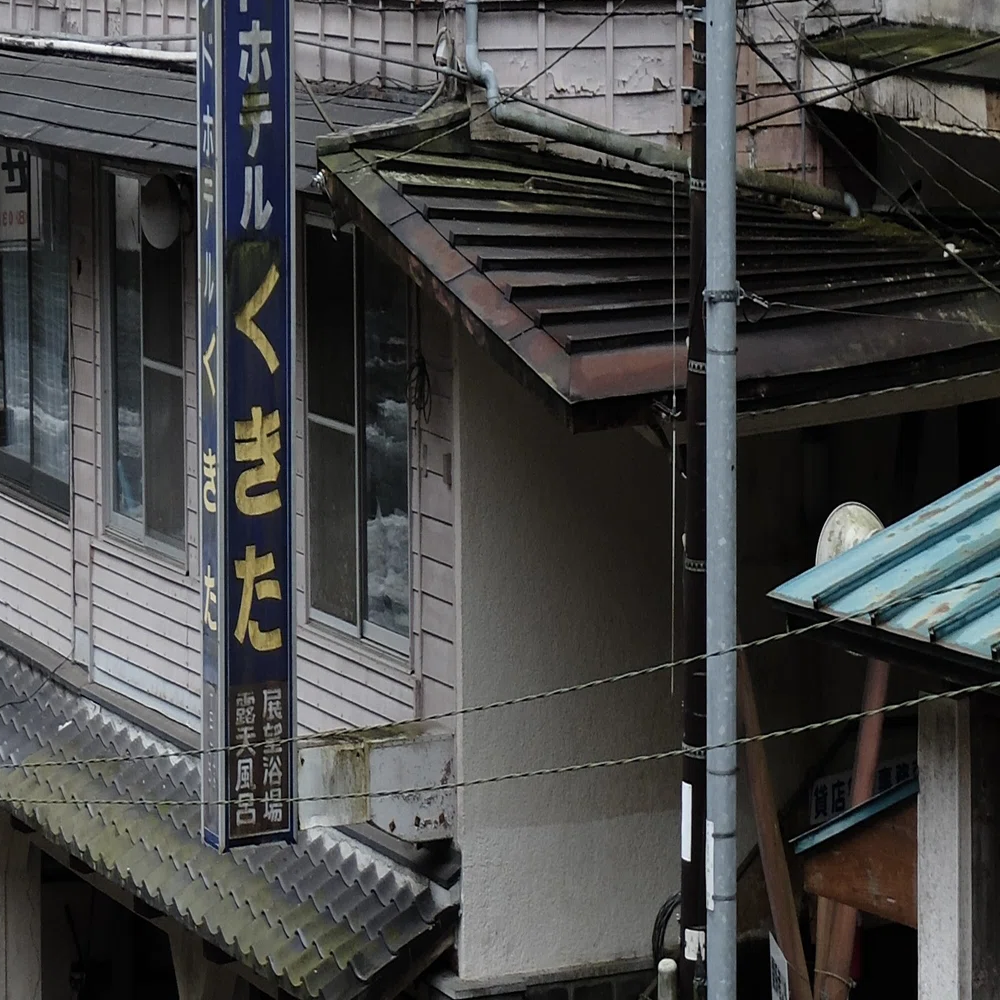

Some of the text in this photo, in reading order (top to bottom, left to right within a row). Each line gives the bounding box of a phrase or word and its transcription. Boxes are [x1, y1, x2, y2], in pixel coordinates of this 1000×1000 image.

[234, 263, 283, 652] くきた
[235, 690, 257, 828] 露天風呂
[262, 687, 284, 823] 展望浴場
